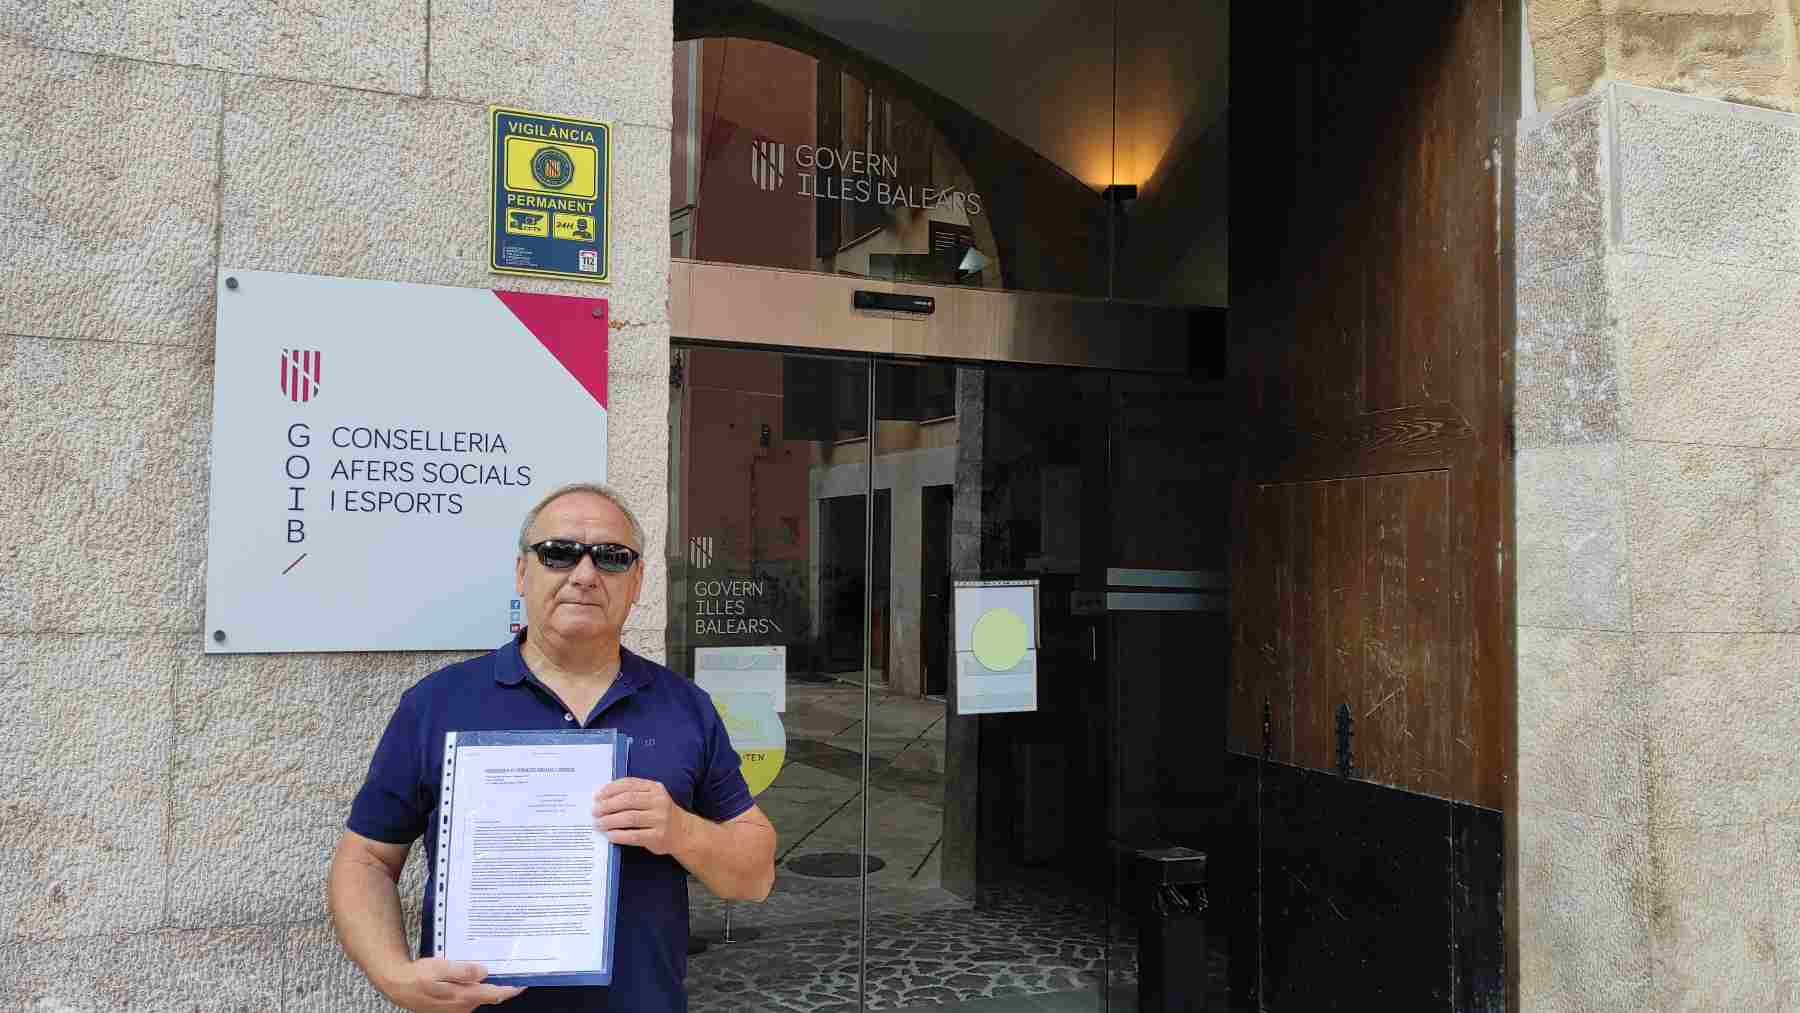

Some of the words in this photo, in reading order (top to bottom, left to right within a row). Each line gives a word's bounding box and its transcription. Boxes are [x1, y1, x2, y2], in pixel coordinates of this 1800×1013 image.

[795, 145, 897, 177] GOVERN
[507, 194, 593, 213] PERMANENT
[797, 173, 870, 203] ILLES
[877, 184, 981, 215] BALEARS
[331, 426, 507, 453] CONSELLERIA
[330, 460, 414, 481] AFERS
[422, 463, 531, 486] SOCIALS
[330, 491, 335, 511] I
[345, 491, 463, 514] ESPORTS
[695, 581, 764, 597] GOVERN
[695, 600, 745, 615] ILLES
